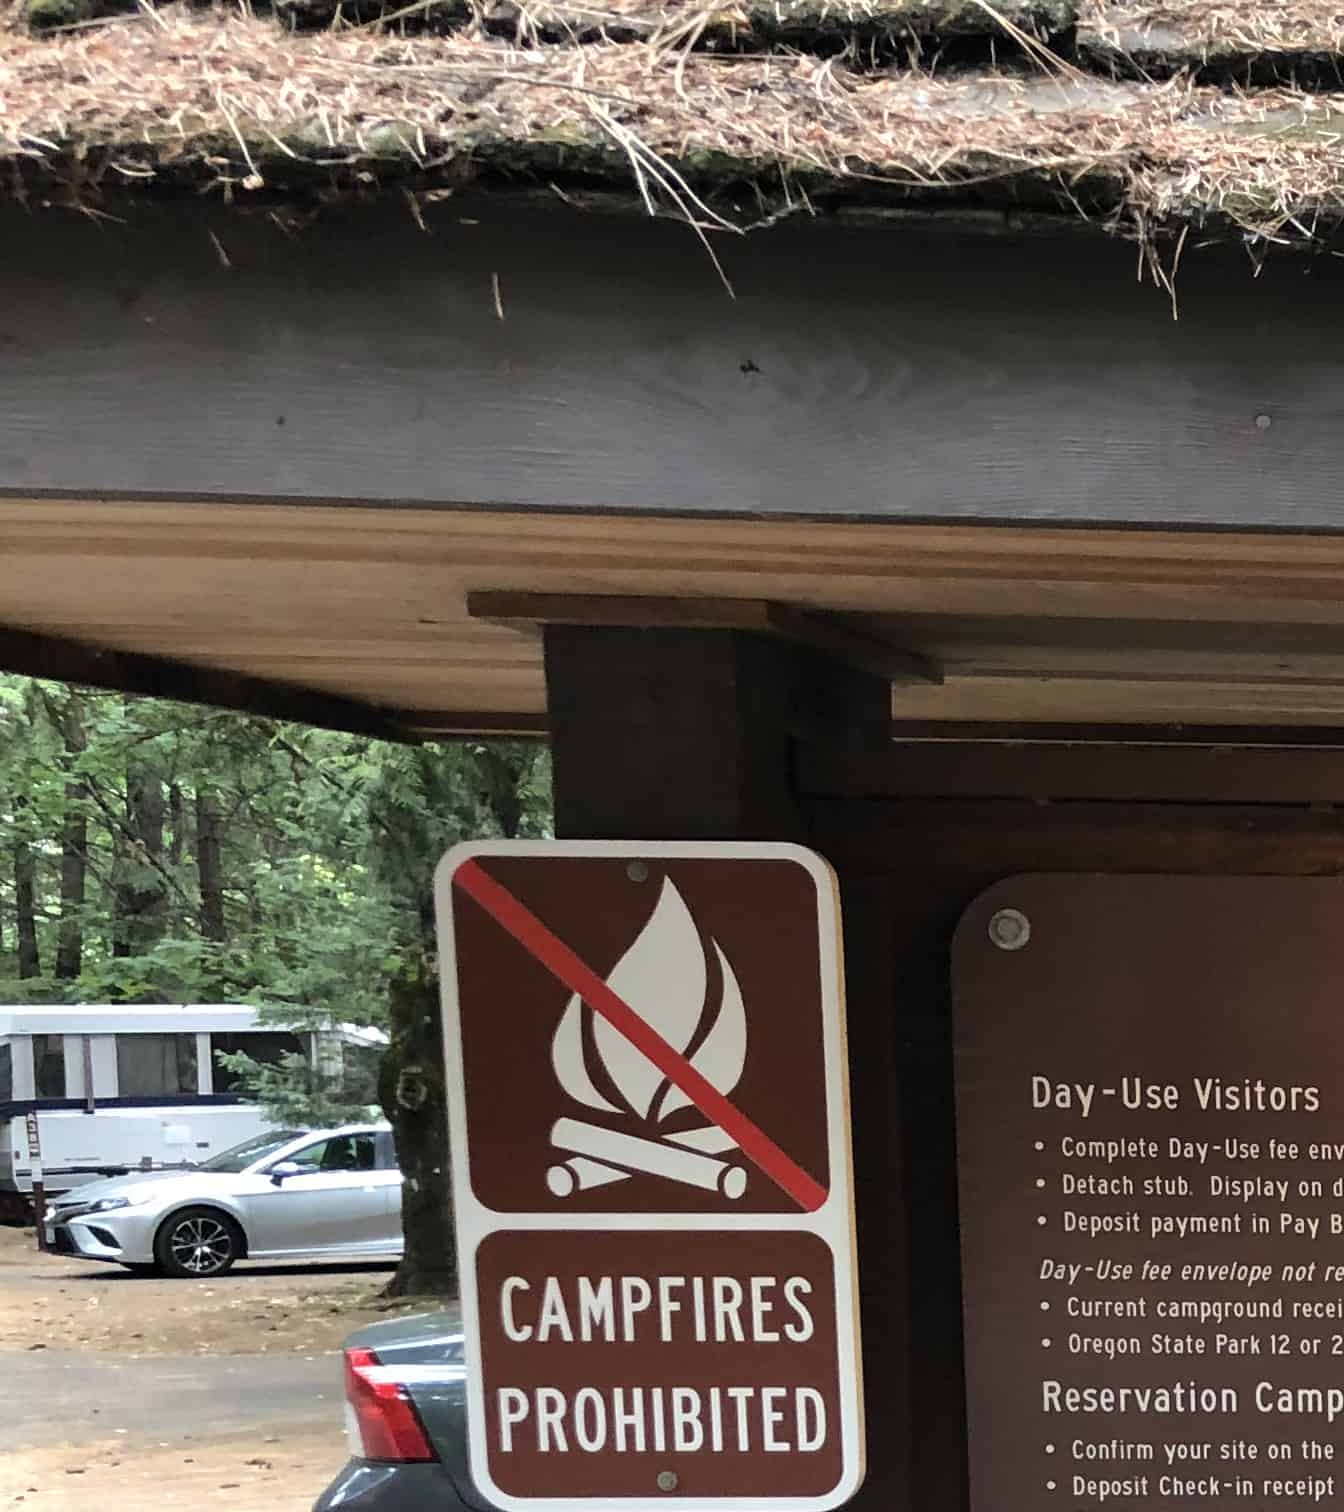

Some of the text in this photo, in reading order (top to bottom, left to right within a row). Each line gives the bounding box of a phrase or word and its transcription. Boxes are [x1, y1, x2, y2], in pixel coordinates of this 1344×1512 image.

[1032, 1076, 1319, 1118] Day-Use Visitors
[1061, 1136, 1158, 1164] Complete
[1169, 1137, 1260, 1164] Day-Use
[1269, 1138, 1299, 1160] fee
[1039, 1259, 1133, 1285] Day-Use
[1141, 1259, 1172, 1281] fee
[1181, 1261, 1273, 1287] envelope
[1281, 1261, 1316, 1282] not
[501, 1276, 814, 1343] CAMPFIRES
[1068, 1333, 1141, 1360] Oregon
[1151, 1333, 1206, 1354] State
[1215, 1333, 1261, 1355] Park
[1270, 1334, 1291, 1355] 12
[1299, 1338, 1321, 1355] or
[1042, 1380, 1237, 1413] Reservation
[498, 1387, 827, 1453] PROHIBITED
[1073, 1475, 1148, 1502] Deposit
[1159, 1475, 1253, 1496] Check-in
[1263, 1475, 1334, 1502] receipt
